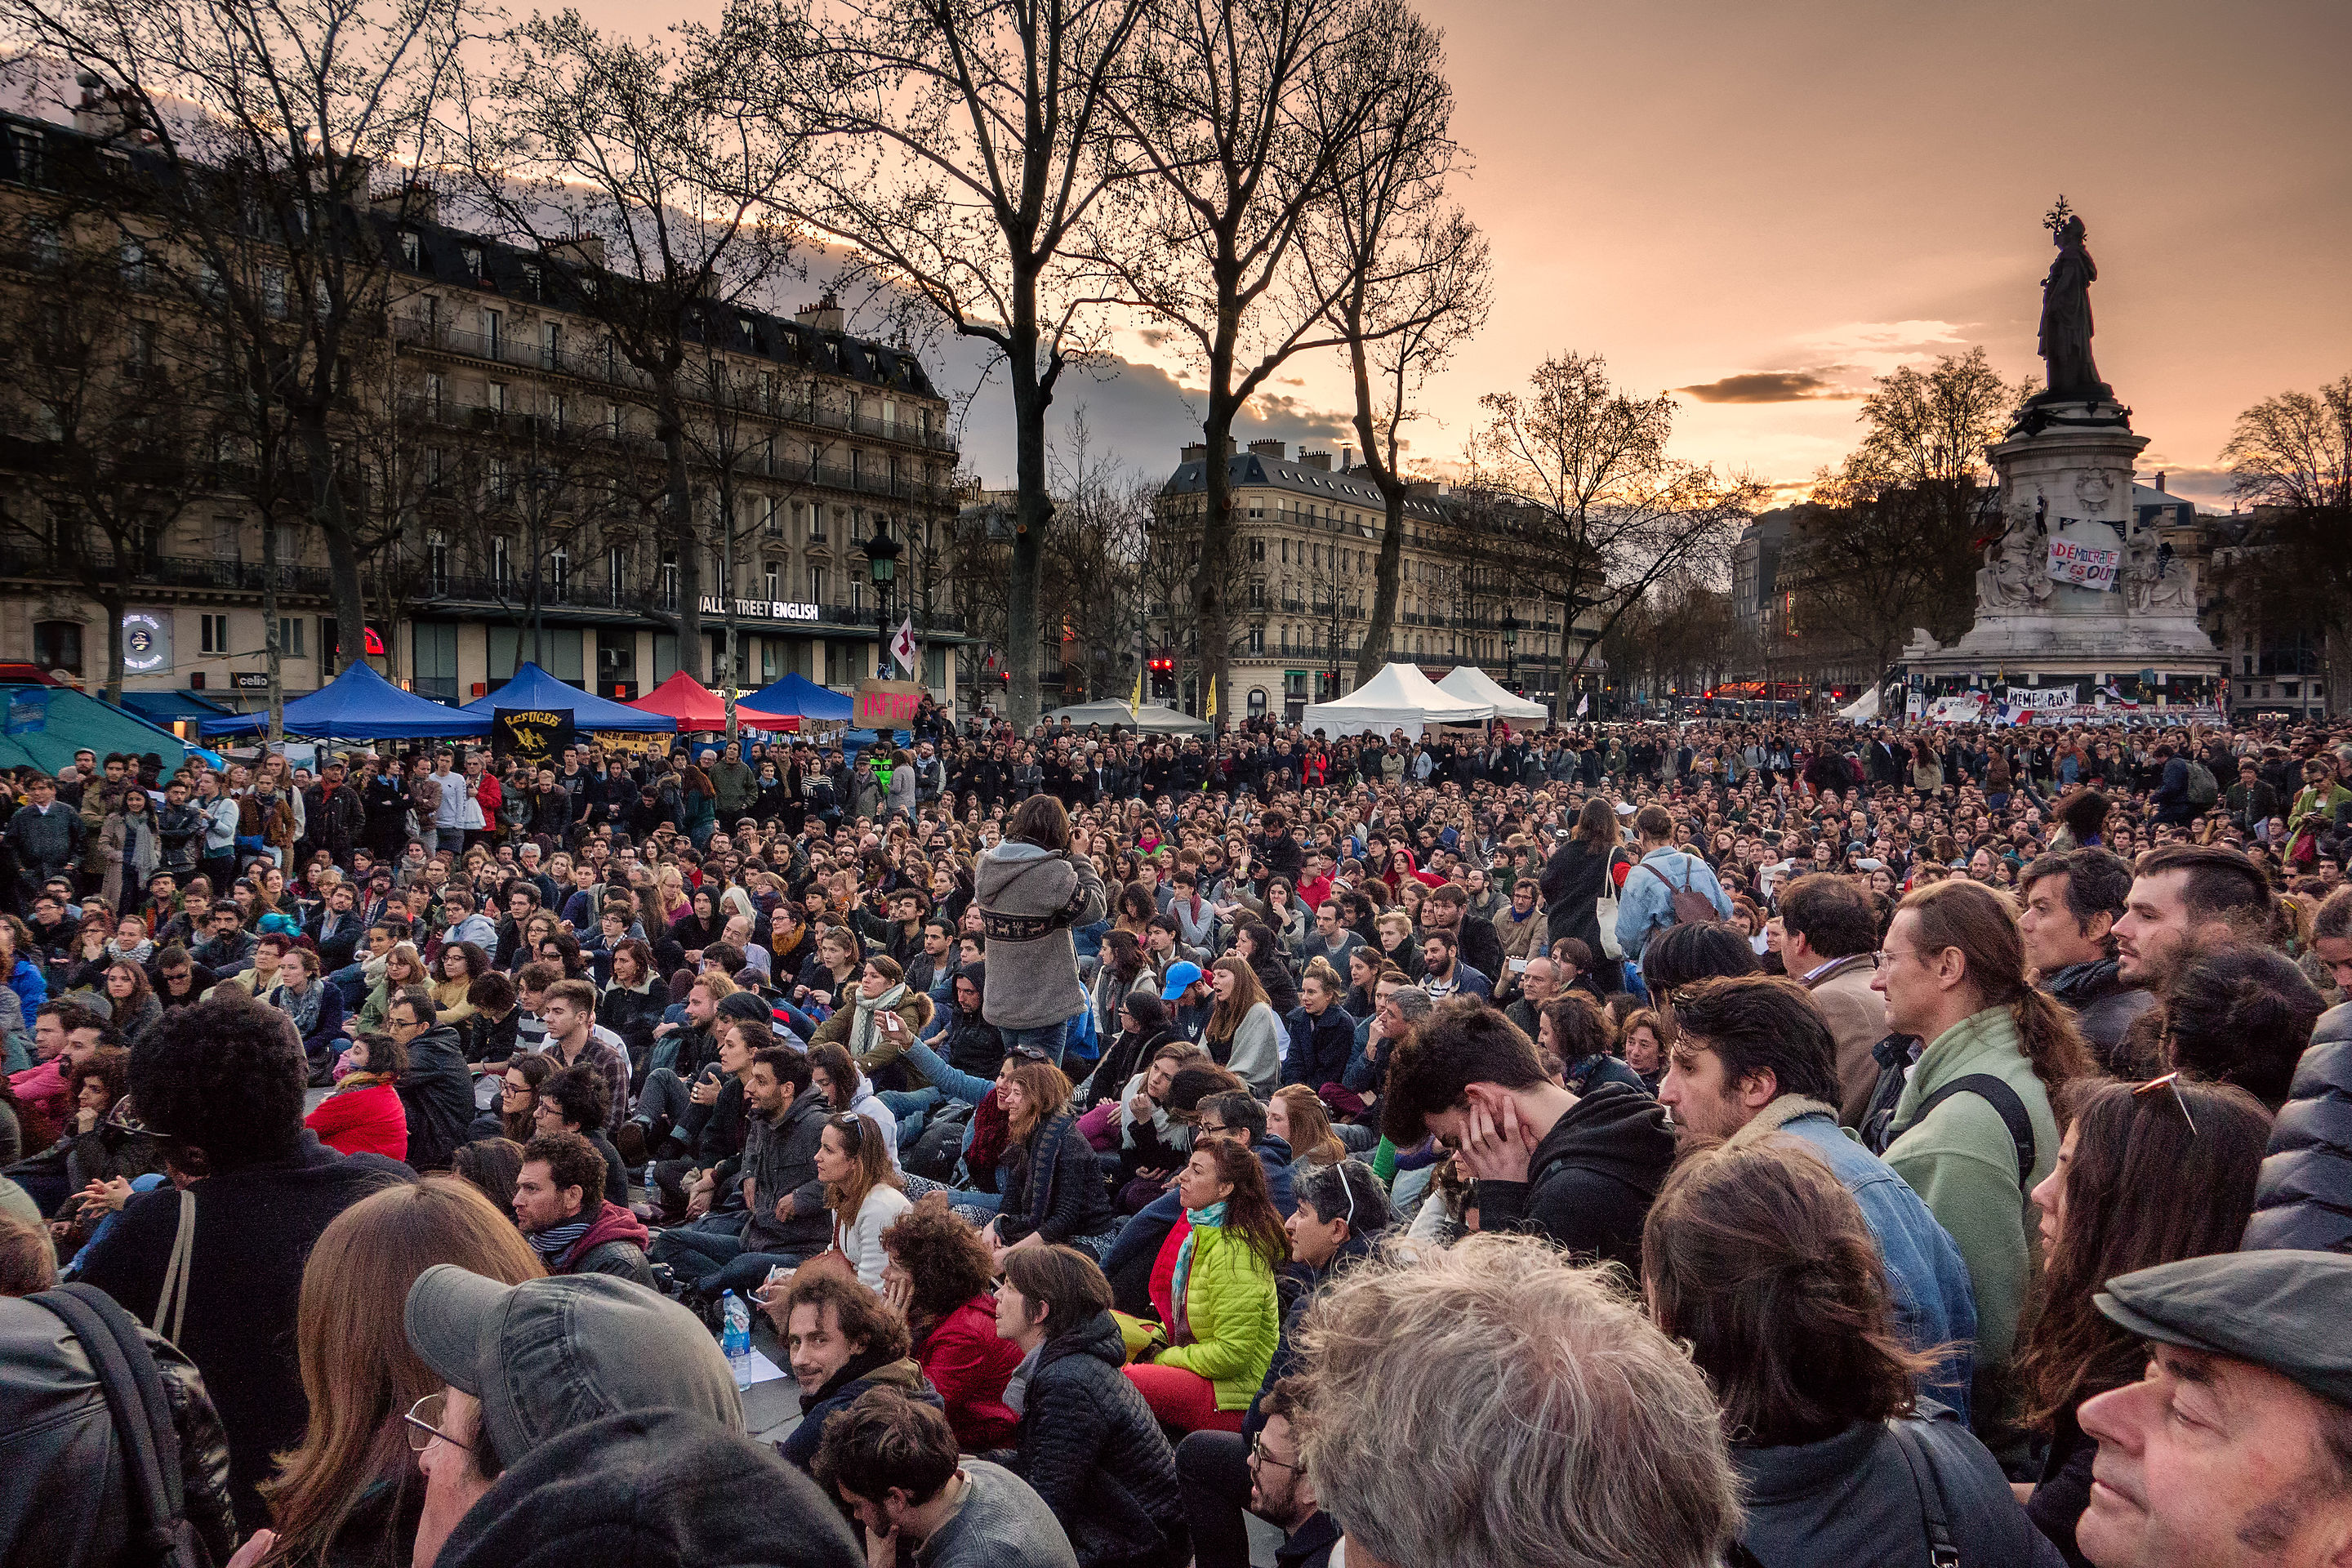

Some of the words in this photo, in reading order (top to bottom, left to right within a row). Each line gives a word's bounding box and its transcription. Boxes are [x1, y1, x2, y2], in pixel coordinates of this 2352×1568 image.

[735, 599, 771, 617] TREET
[773, 601, 818, 621] ENGLISH
[240, 675, 268, 685] celio
[2009, 690, 2038, 709] MÊME
[2047, 691, 2069, 708] PEUR
[504, 711, 563, 727] REFUGEES
